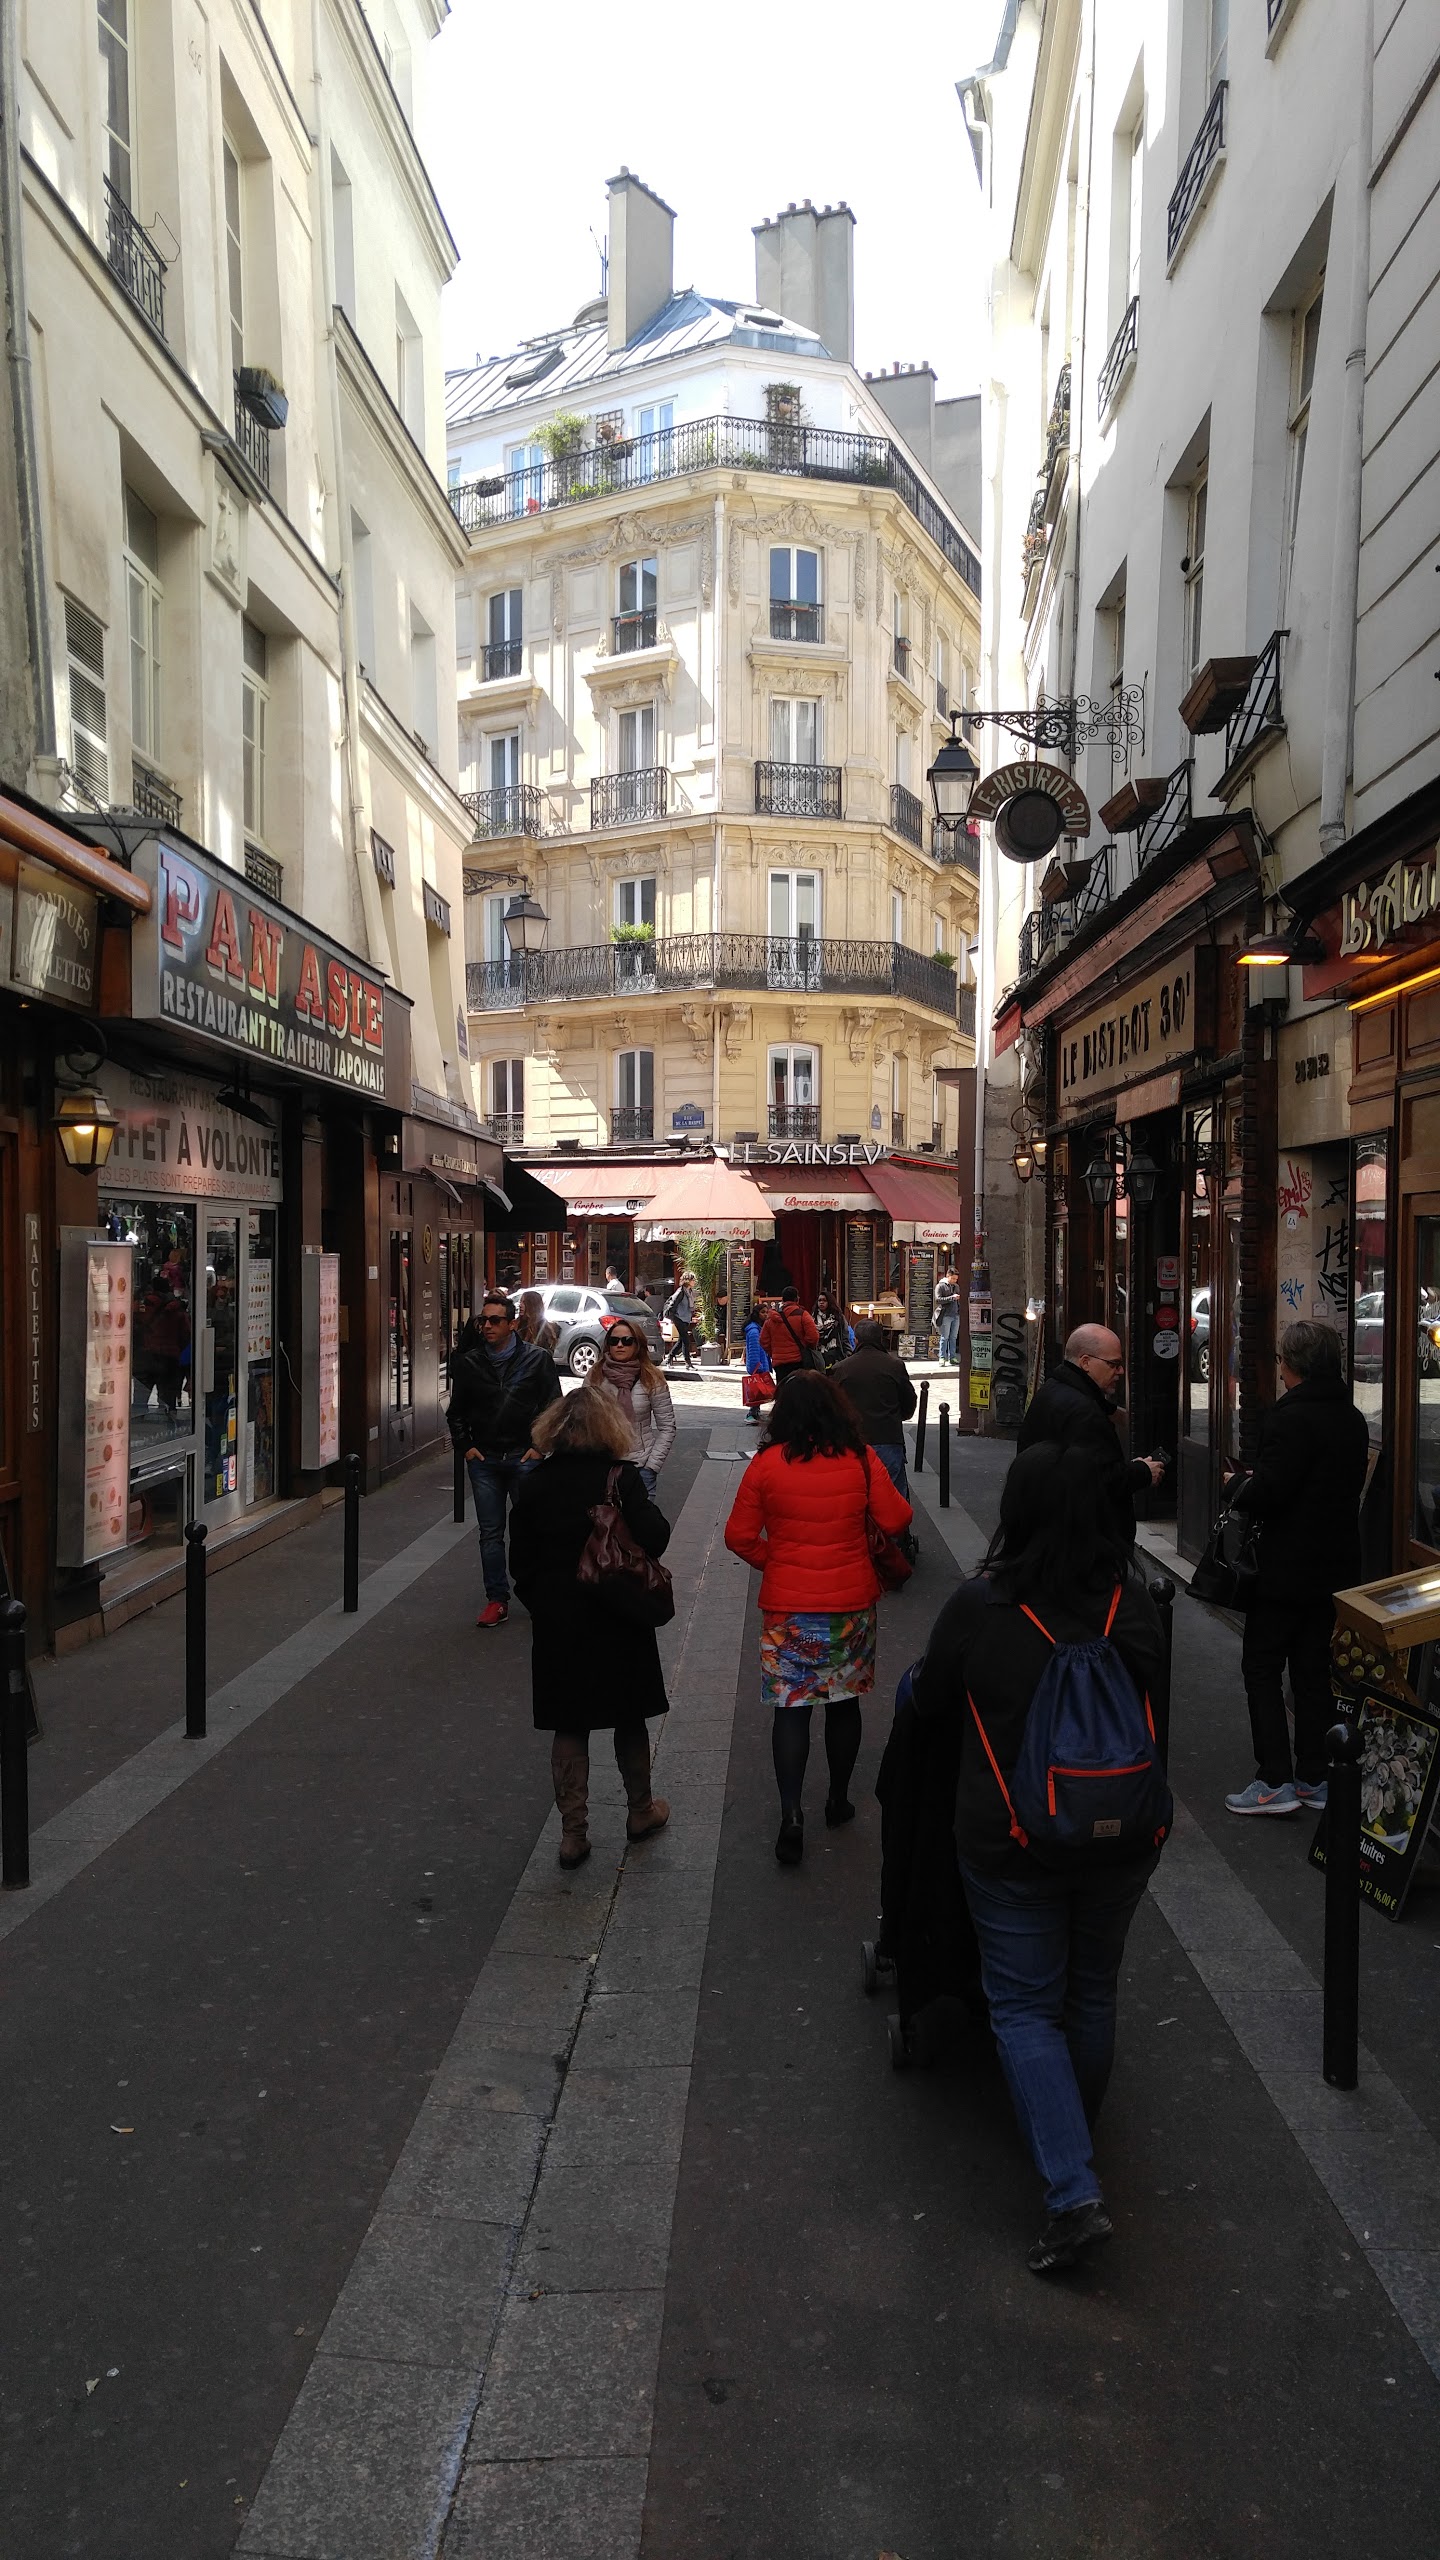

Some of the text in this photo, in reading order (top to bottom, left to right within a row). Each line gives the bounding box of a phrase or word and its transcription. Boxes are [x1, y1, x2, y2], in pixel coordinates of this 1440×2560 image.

[26, 890, 90, 950] FONDUES
[160, 851, 383, 1050] PAN ASIE
[162, 970, 386, 1092] RESTAURANT TRAITEUR JAPONAIS
[1063, 1042, 1078, 1089] LE
[1082, 998, 1152, 1080] BISTROT
[129, 1072, 199, 1109] RESTAURANT
[177, 1111, 192, 1166] À
[197, 1125, 280, 1179] VOLONTÉ
[728, 1142, 758, 1164] LE
[114, 1167, 131, 1183] LES
[133, 1169, 158, 1186] PLATS
[160, 1173, 183, 1188] SONT
[221, 1179, 236, 1193] SUR
[236, 1182, 271, 1198] COMMANDE
[783, 1196, 840, 1208] Brasserie
[573, 1200, 605, 1213] Crêpes
[697, 1226, 717, 1236] Non
[728, 1226, 752, 1238] Stop
[921, 1229, 949, 1238] Cuisine
[29, 1219, 42, 1429] RACLETTES
[1313, 1846, 1324, 1862] Les
[1363, 1880, 1373, 1894] 12
